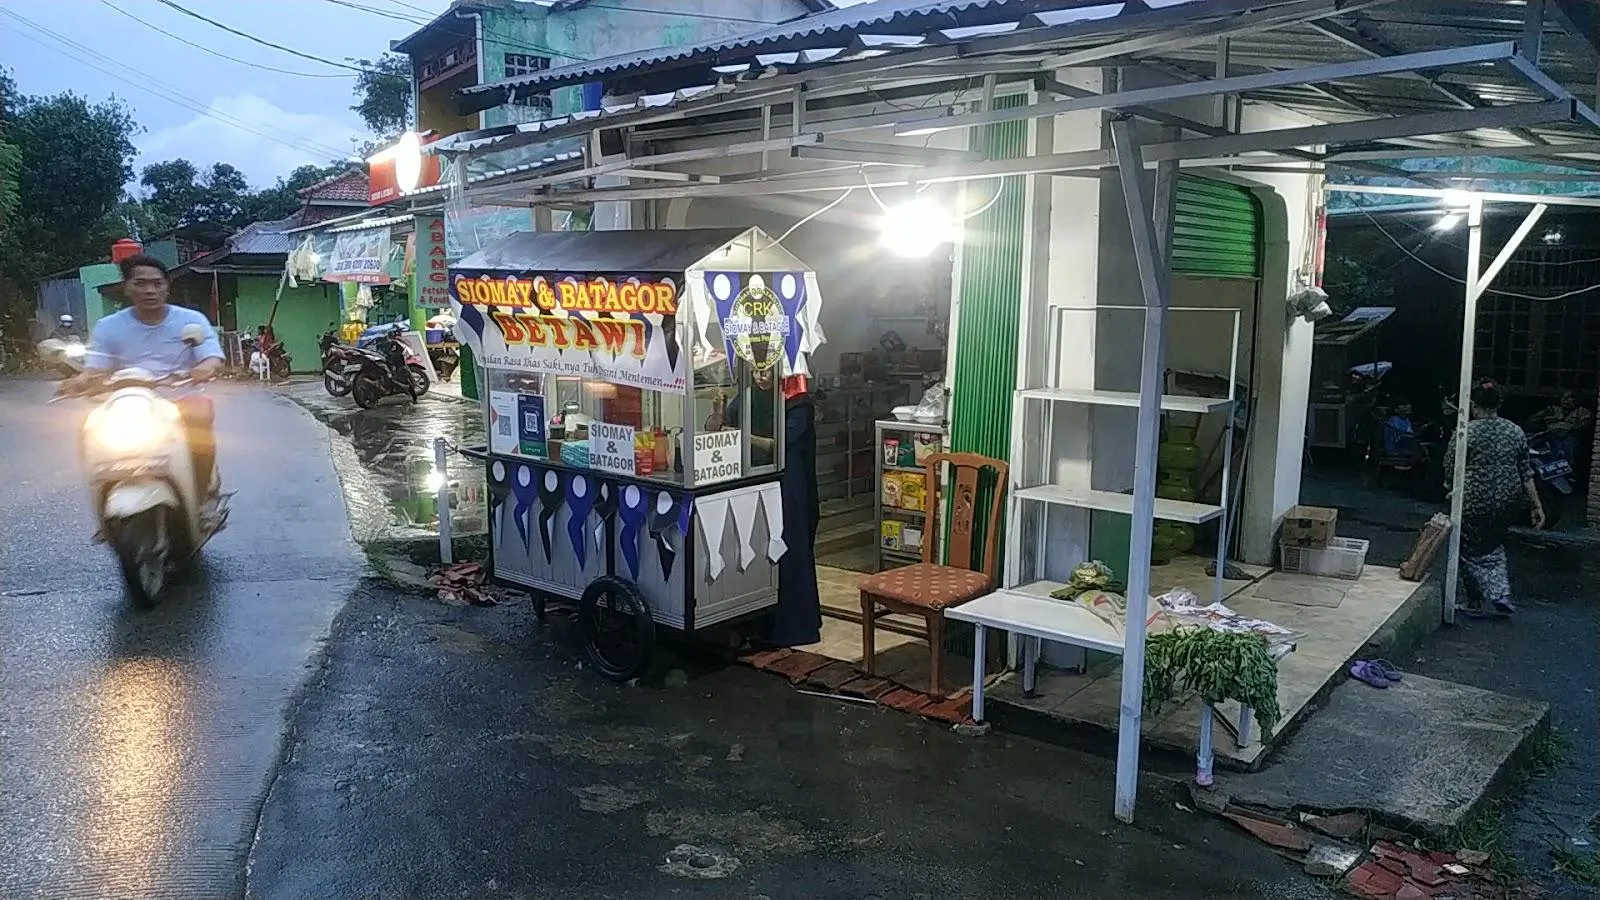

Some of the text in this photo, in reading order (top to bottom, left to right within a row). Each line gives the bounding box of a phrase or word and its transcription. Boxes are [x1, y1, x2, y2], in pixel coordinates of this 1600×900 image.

[456, 279, 677, 315] SIOMAY & BATAGOR
[743, 302, 773, 316] CRK
[493, 311, 646, 359] BETAWI
[725, 320, 750, 334] SIOMAY
[591, 424, 633, 442] SIOMAY
[695, 433, 739, 451] SIOMAY
[606, 441, 618, 453] &
[589, 453, 634, 472] BATAGOR
[711, 450, 723, 464] &
[694, 462, 740, 482] BATAGOR
